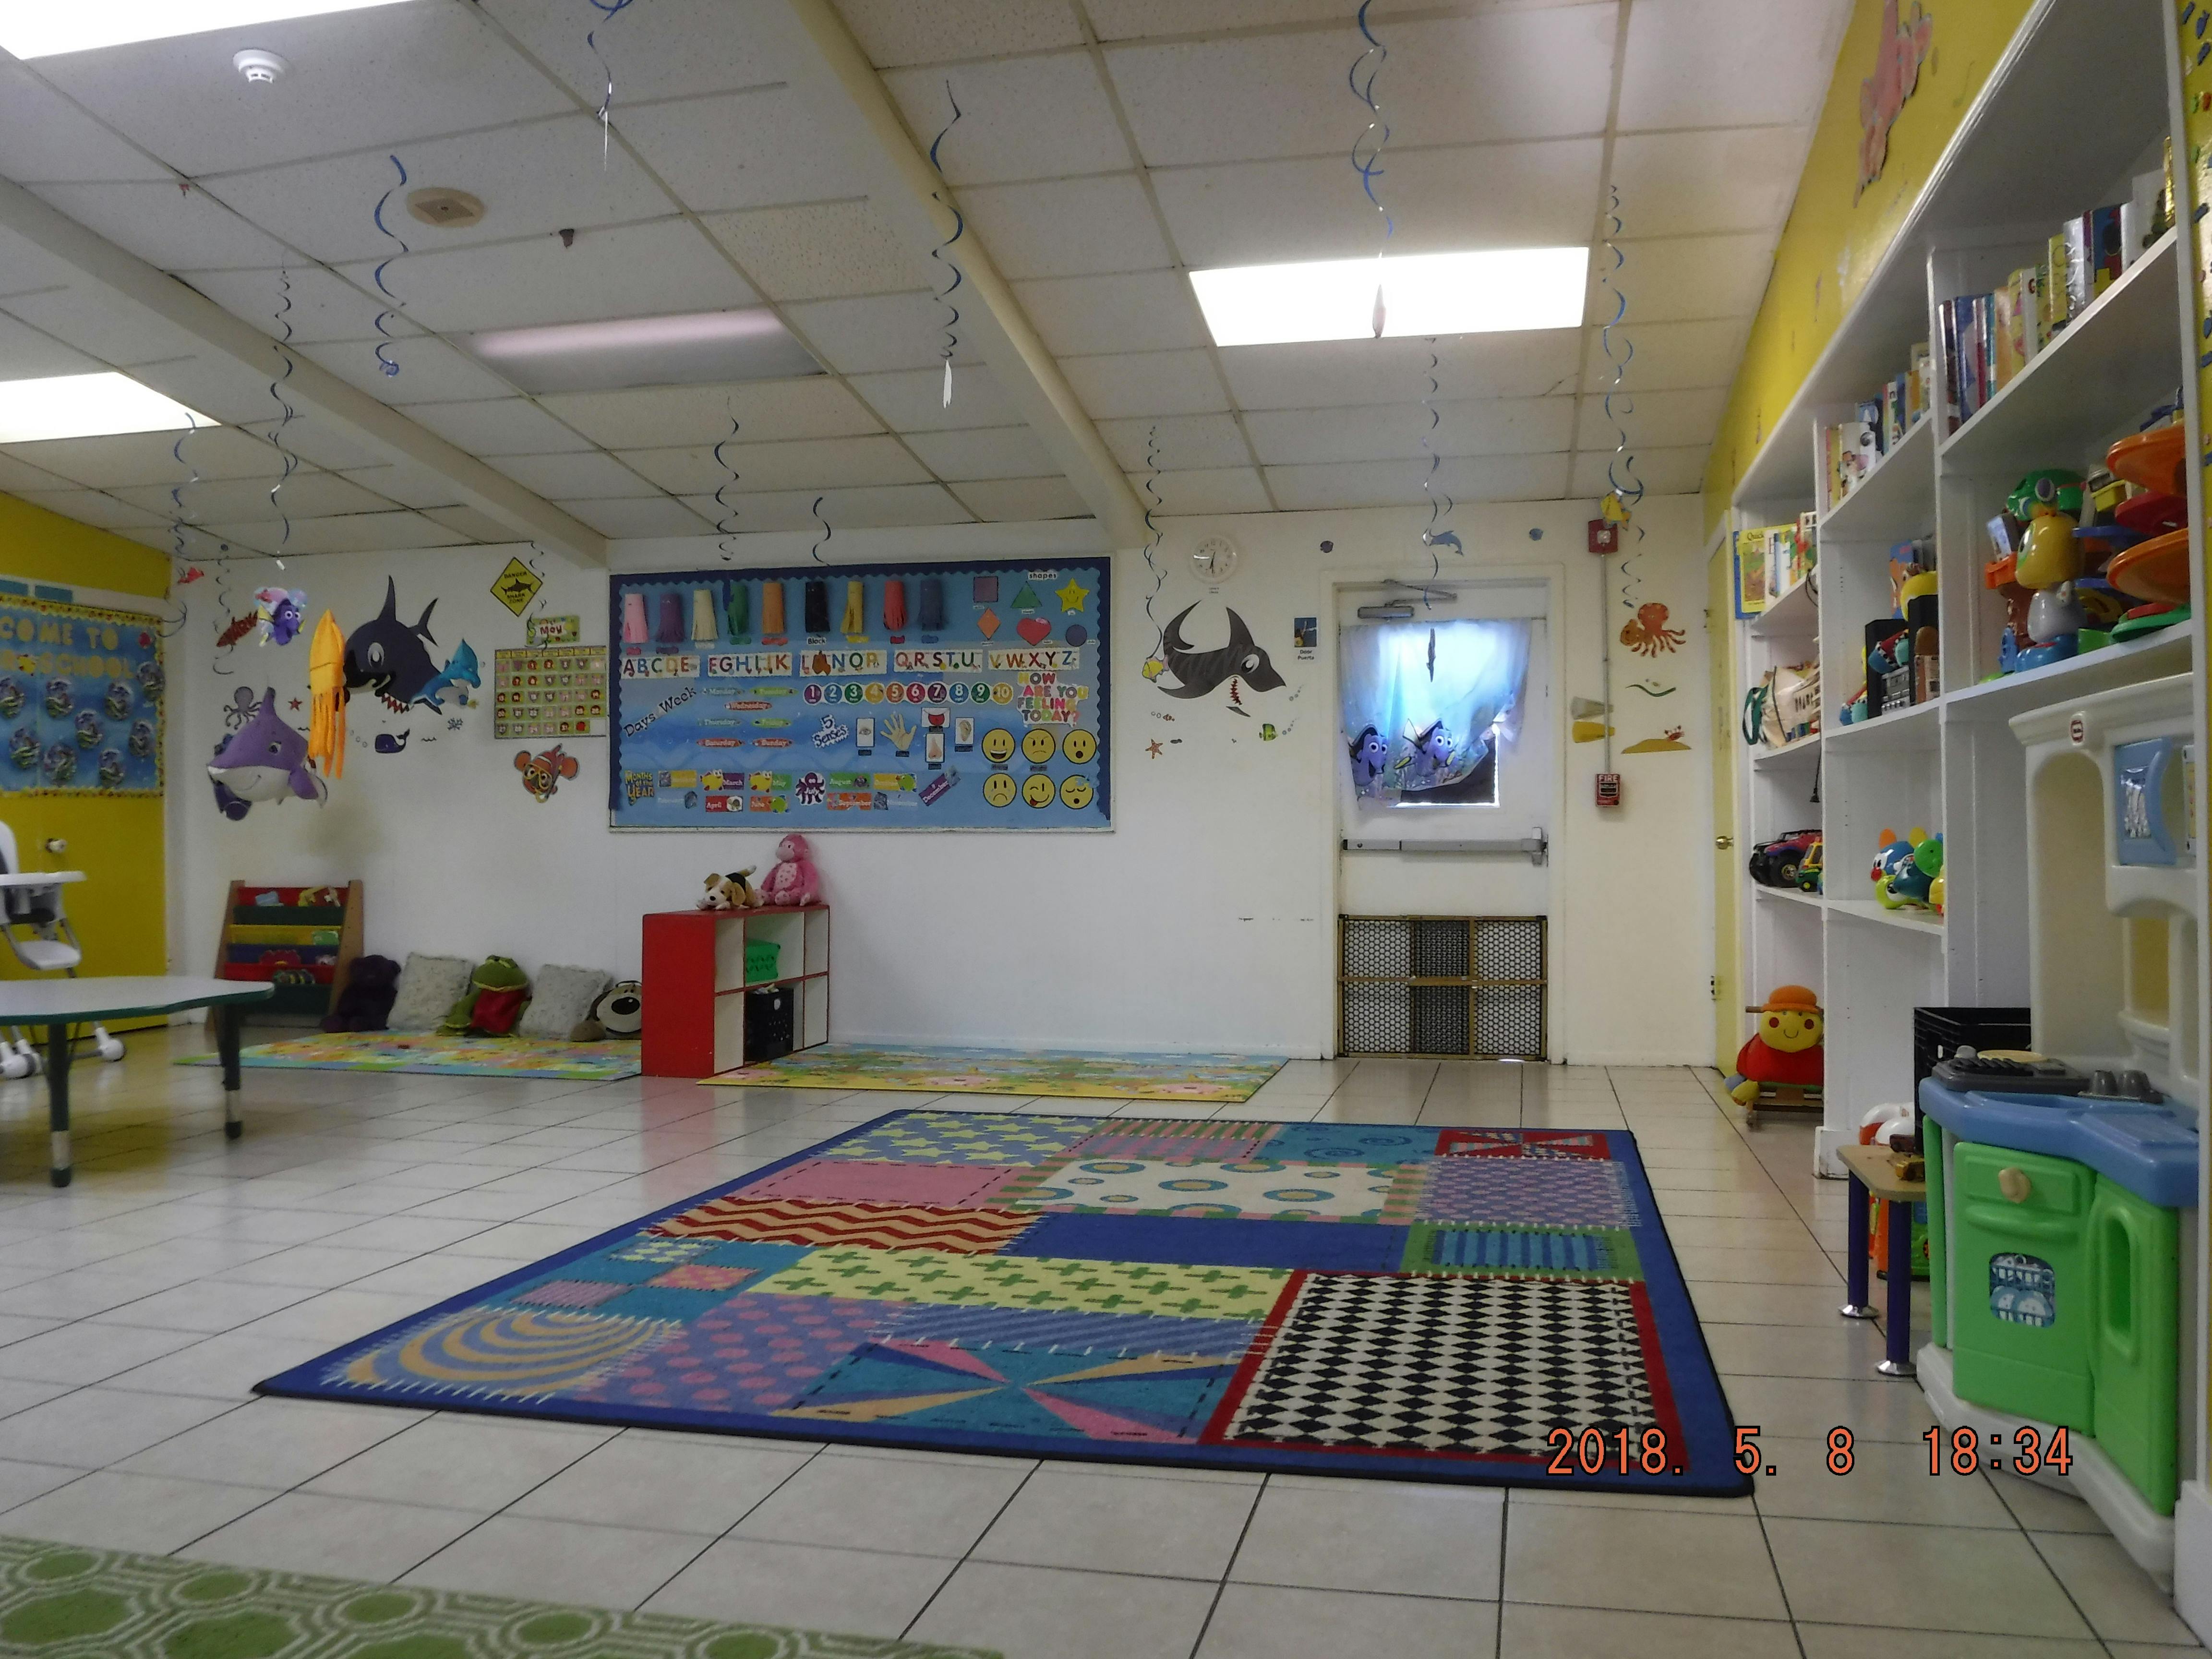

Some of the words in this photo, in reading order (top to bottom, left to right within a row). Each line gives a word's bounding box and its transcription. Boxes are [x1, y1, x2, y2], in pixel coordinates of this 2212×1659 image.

[540, 625, 563, 635] May
[86, 626, 119, 651] TO
[1018, 672, 1056, 685] HOW
[810, 684, 815, 698] 1
[829, 685, 837, 697] 2
[850, 685, 858, 697] 3
[870, 685, 878, 697] 4
[891, 685, 900, 697] 5
[911, 684, 920, 697] 6
[933, 684, 941, 697] 7
[955, 684, 963, 697] 8
[977, 684, 986, 697] 9
[998, 686, 1010, 698] 10
[1022, 685, 1052, 697] ARE
[1057, 685, 1089, 698] YOU
[1017, 697, 1076, 711] FEELING
[623, 712, 656, 737] Days
[658, 686, 697, 713] Week
[821, 715, 833, 729] 5
[814, 725, 847, 746] Senses
[804, 787, 820, 795] July
